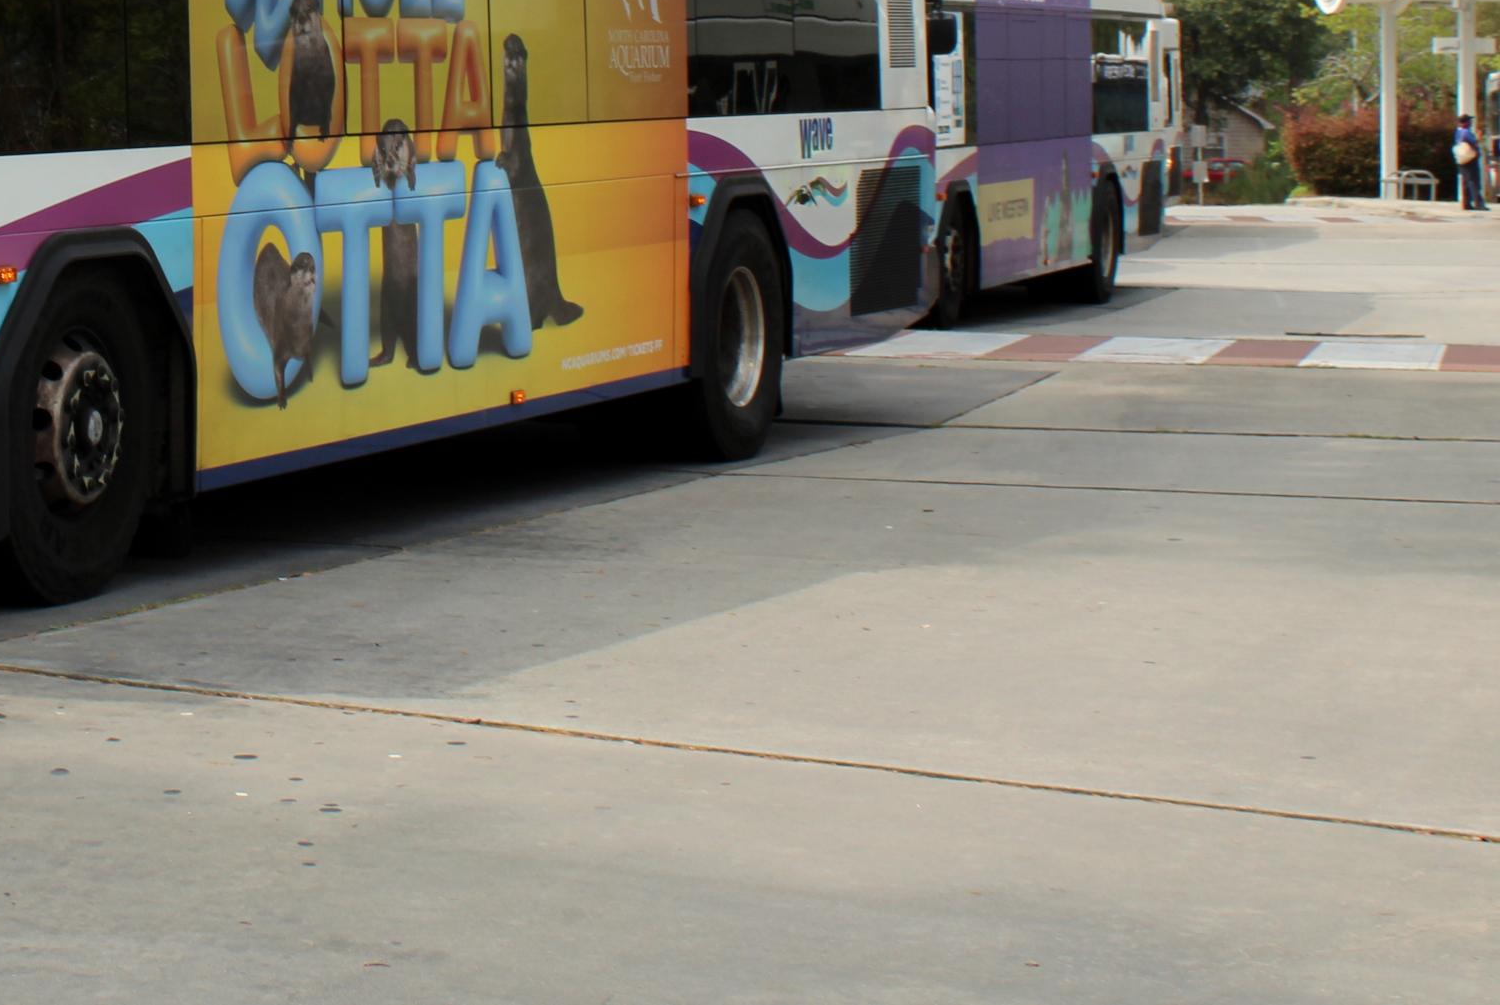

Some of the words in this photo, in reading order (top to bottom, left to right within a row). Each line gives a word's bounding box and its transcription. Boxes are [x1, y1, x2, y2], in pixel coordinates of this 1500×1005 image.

[608, 29, 633, 43] NORTH
[635, 30, 669, 43] CAROLINA
[608, 45, 670, 76] AQUARIUM
[217, 17, 498, 186] LOTTA
[217, 160, 533, 401] OTTA
